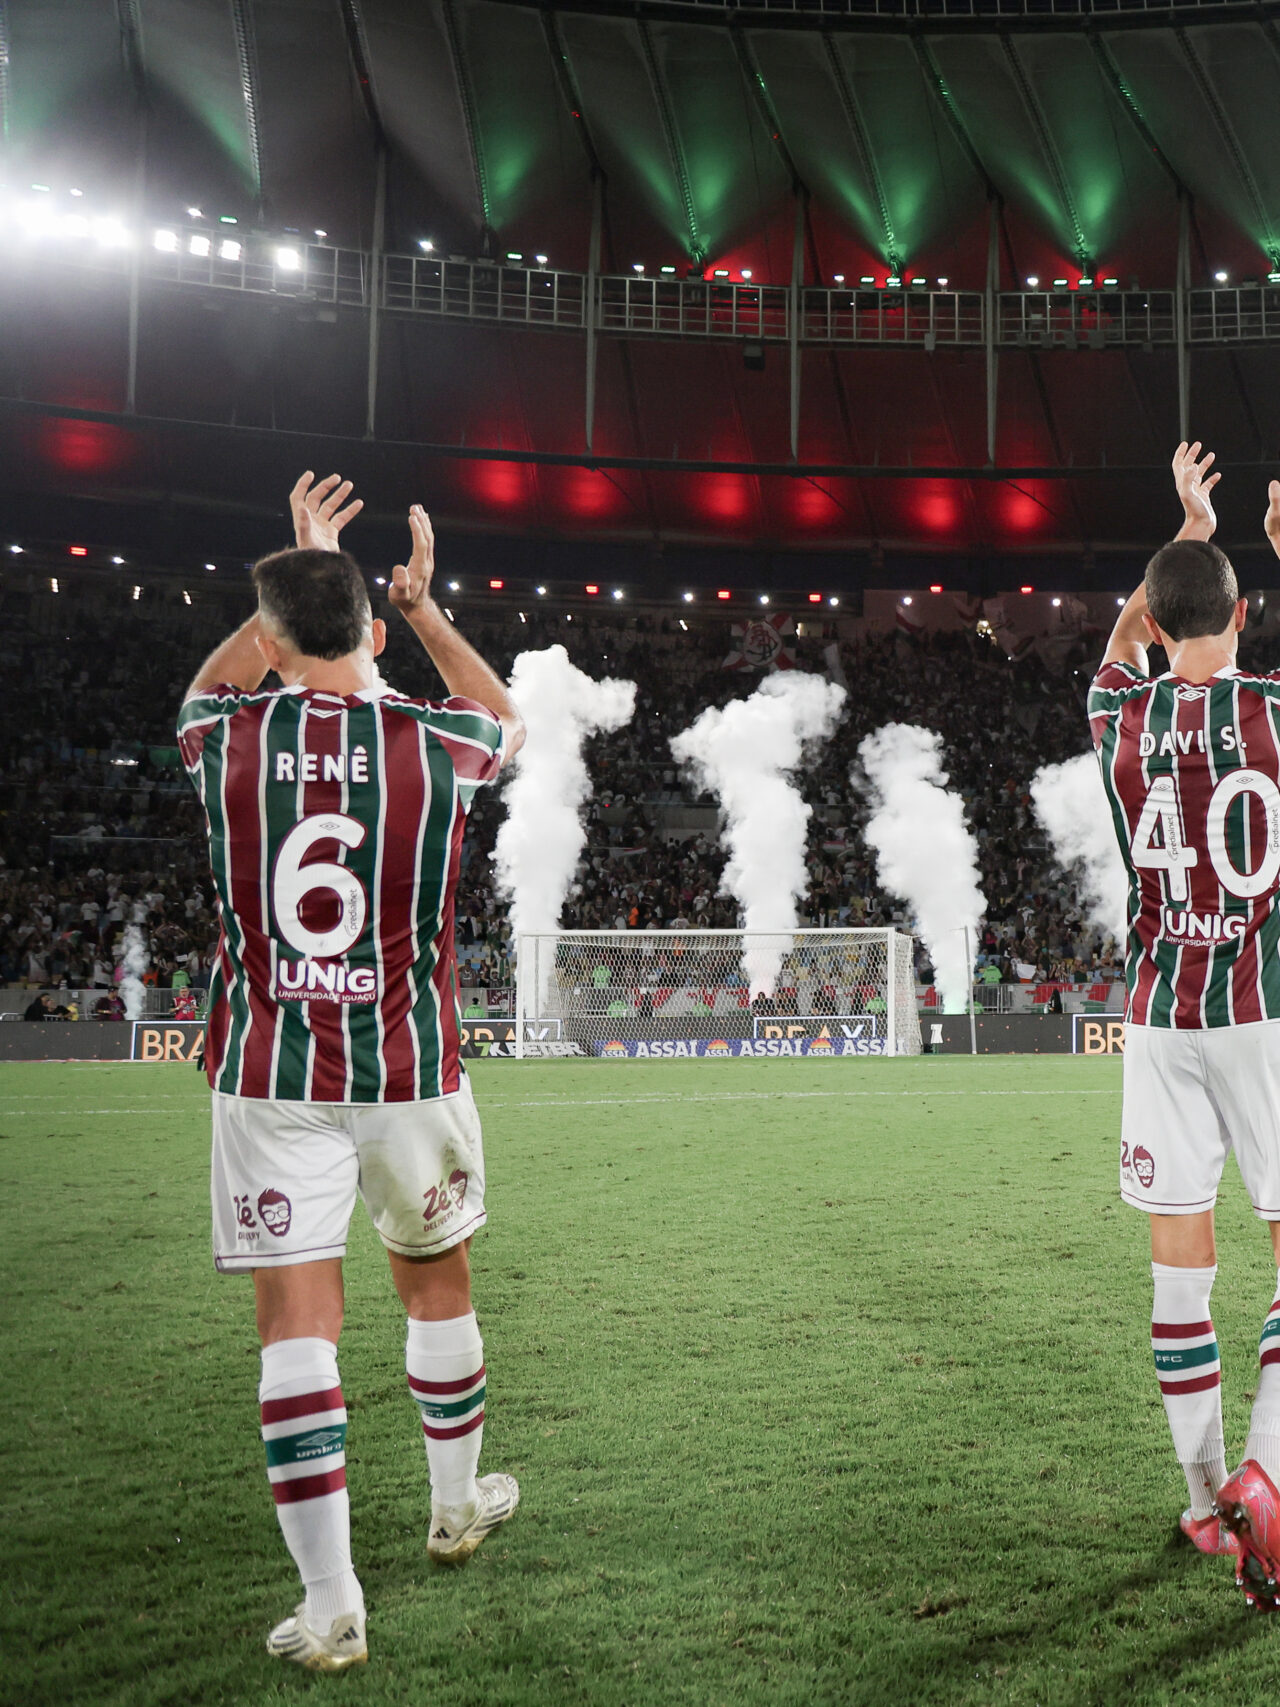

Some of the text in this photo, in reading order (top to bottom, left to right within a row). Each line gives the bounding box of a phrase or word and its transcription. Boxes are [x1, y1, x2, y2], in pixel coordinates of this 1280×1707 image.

[1138, 725, 1248, 757] DAVI S.
[276, 745, 369, 783] RENÊ
[1167, 815, 1179, 856] predialnet
[273, 812, 366, 958] 6
[1165, 909, 1246, 939] UNIG
[1165, 935, 1217, 947] UNIVERSIDADE
[279, 959, 376, 993] UNIG
[278, 990, 341, 1002] UNIVERSIDADE
[341, 993, 376, 1003] IGUAÇU
[142, 1029, 205, 1060] BRA
[1084, 1022, 1126, 1054] BR
[422, 1179, 452, 1222] Zé
[1155, 1354, 1184, 1363] FFC
